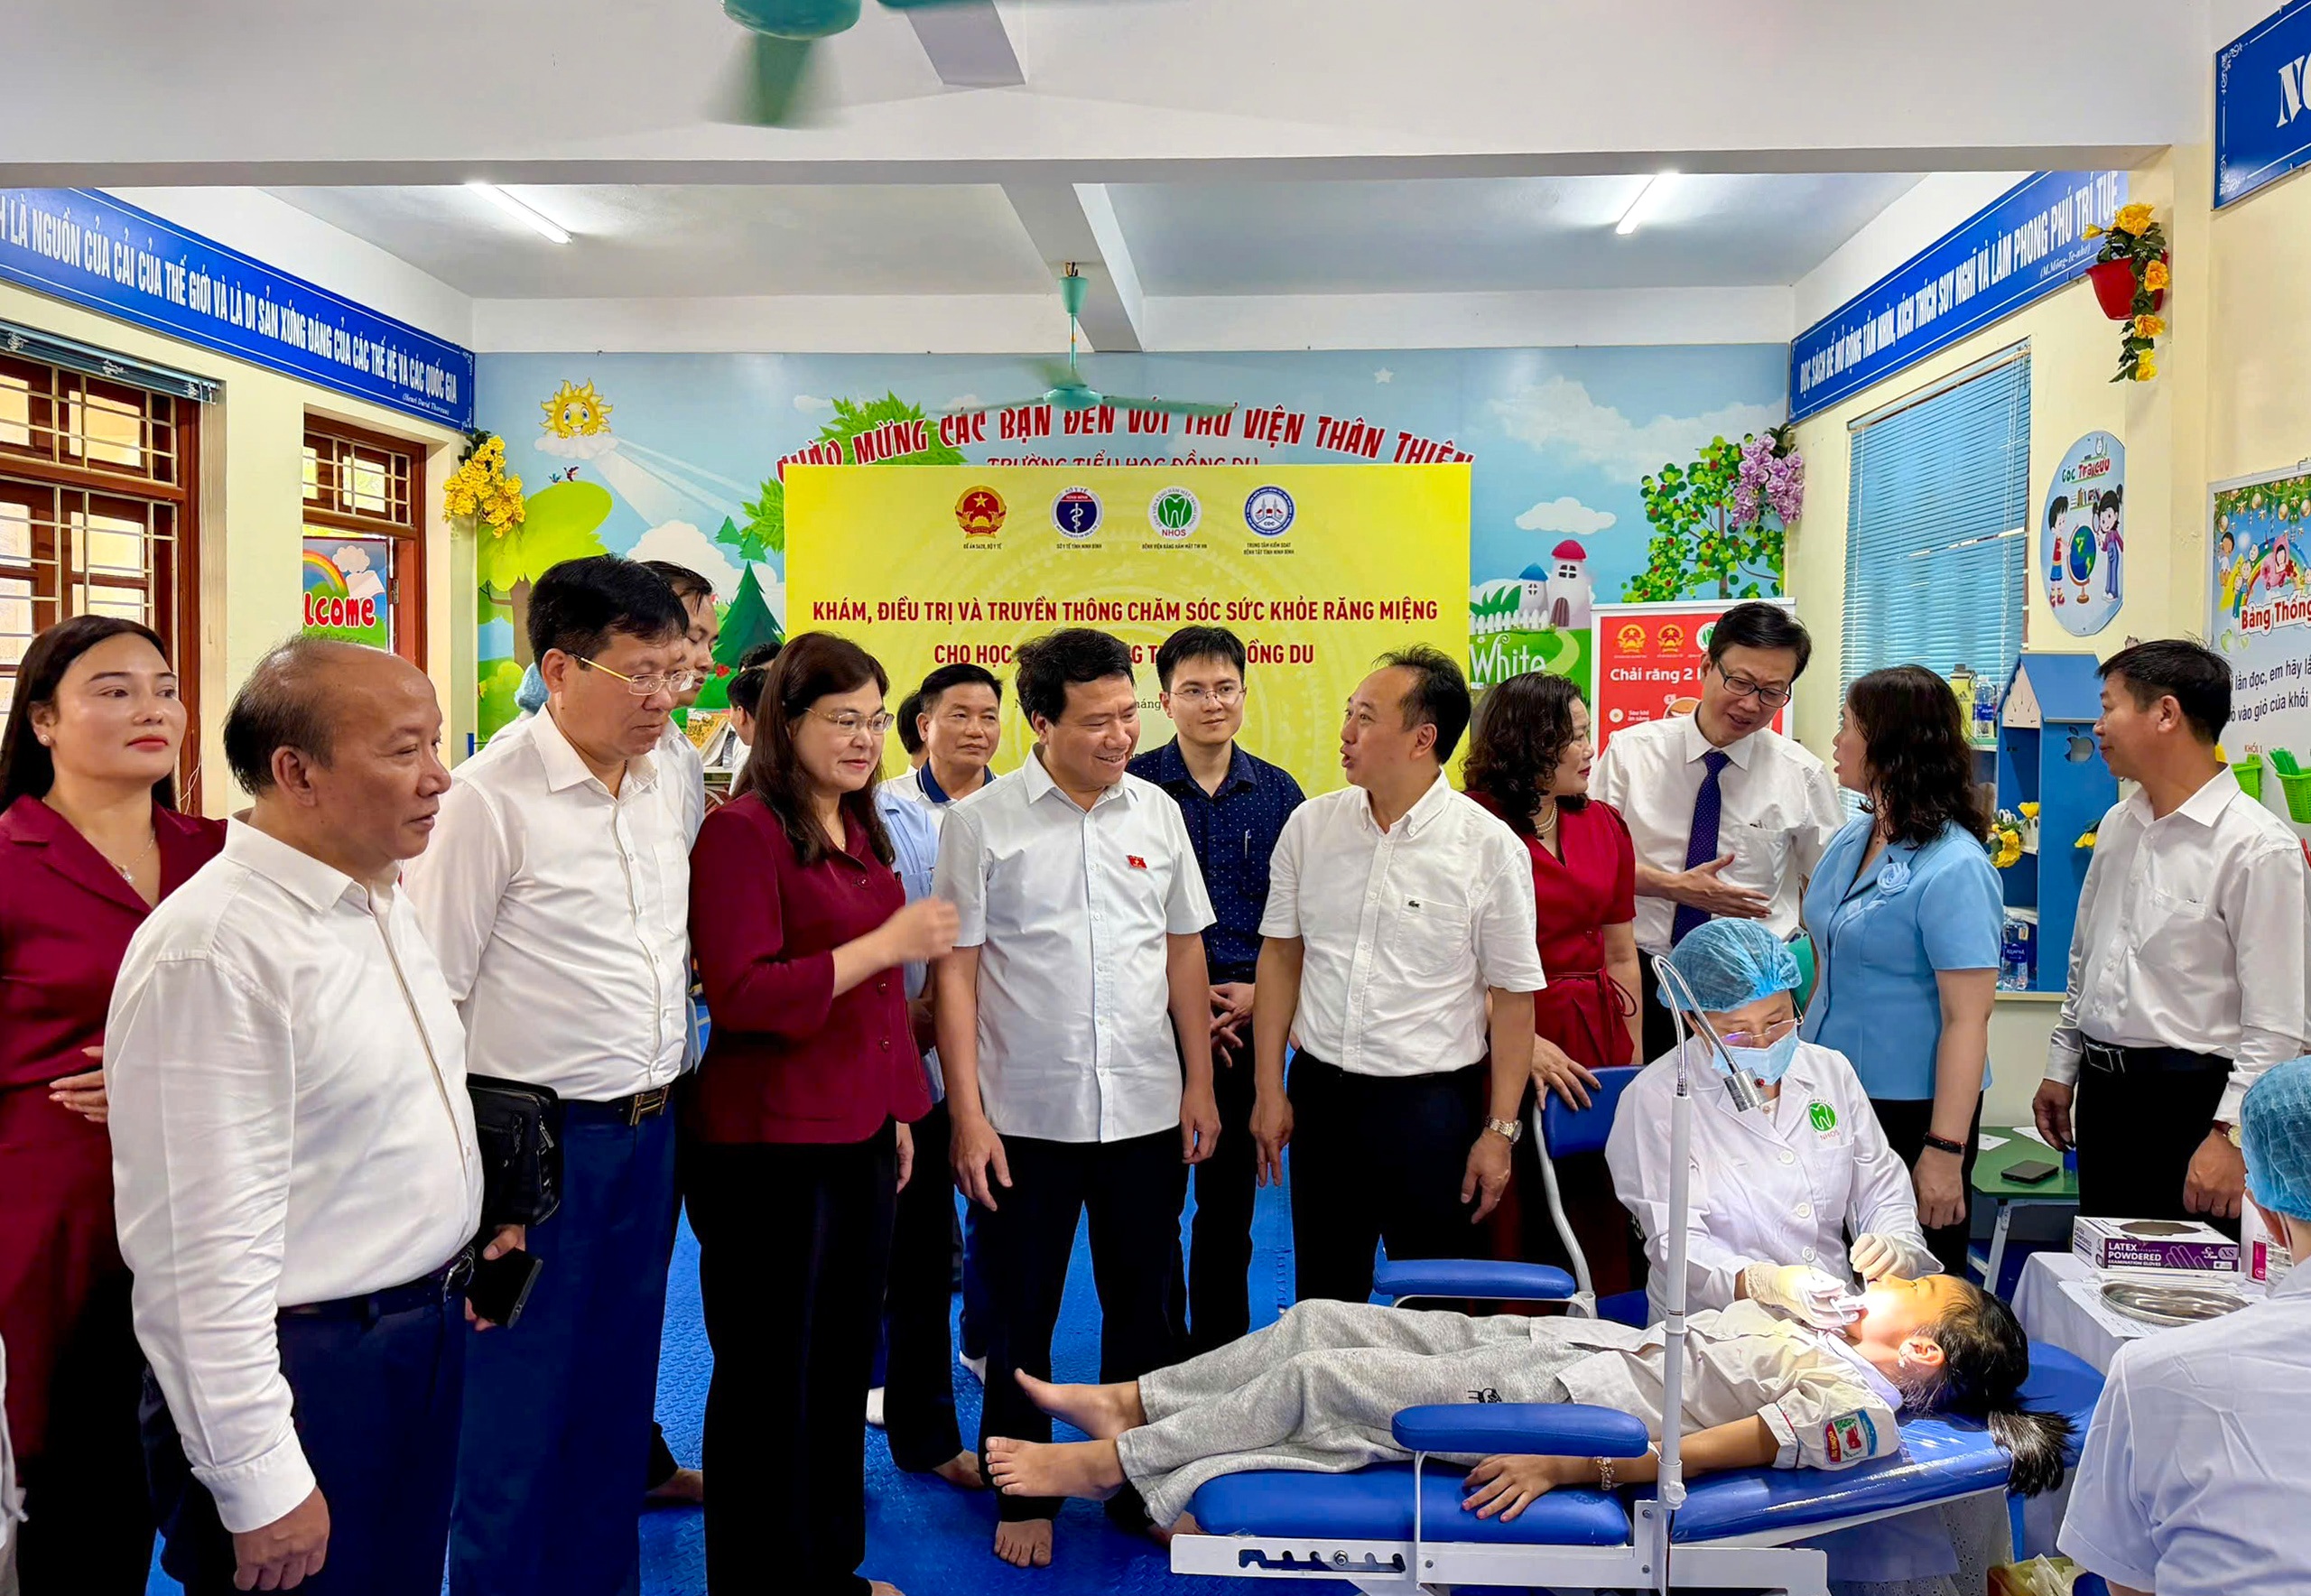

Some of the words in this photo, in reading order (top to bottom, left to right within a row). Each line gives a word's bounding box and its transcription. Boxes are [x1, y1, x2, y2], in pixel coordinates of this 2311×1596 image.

[1897, 292, 1915, 340] KÍCH
[1915, 278, 1937, 329] THÍCH
[1938, 268, 1954, 316] SUY
[1977, 238, 1990, 292] VÀ
[1991, 229, 2012, 285] LÀM
[2013, 210, 2048, 273] PHONG
[2050, 184, 2073, 252] PHÚ
[2075, 171, 2093, 237] TRÍ
[10, 193, 28, 248] LÀ
[32, 207, 80, 268] NGUỒN
[84, 215, 110, 279] CỦA
[114, 227, 135, 288] CẢI
[137, 237, 162, 298] CỦA
[164, 255, 187, 306] THẾ
[189, 264, 211, 315] GIỚI
[213, 274, 227, 321] VÀ
[229, 281, 243, 327] LÀ
[245, 292, 255, 331] DI
[258, 284, 279, 339] SẢN
[280, 299, 306, 349] XỨNG
[308, 313, 332, 359] ĐÁNG
[334, 316, 351, 367] CỦA
[353, 330, 369, 373] CÁC
[370, 336, 386, 378] THẾ
[386, 344, 397, 389] HỆ
[398, 348, 408, 386] VÀ
[409, 353, 424, 392] CÁC
[425, 357, 444, 399] QUỐC
[445, 372, 457, 404] GIA
[853, 419, 928, 465] MỪNG
[940, 406, 987, 446] CÁC
[1000, 404, 1052, 444] BẠN
[1243, 404, 1305, 449] VIỆN
[1315, 416, 1386, 459] THÂN
[1162, 528, 1186, 537] NHOS
[305, 593, 376, 626] lcome
[812, 597, 873, 626] KHÁM,
[877, 596, 919, 621] ĐIỀU
[923, 601, 953, 626] TRỊ
[958, 597, 983, 621] VÀ
[987, 596, 1057, 621] TRUYỀN
[1062, 597, 1123, 621] THÔNG
[1128, 598, 1180, 621] CHĂM
[1185, 597, 1220, 621] SÓC
[1226, 596, 1265, 621] SỨC
[1270, 595, 1318, 621] KHỎE
[1323, 597, 1374, 621] RĂNG
[1379, 596, 1438, 624] MIỆNG
[2241, 606, 2270, 630] Bảng
[2274, 594, 2311, 622] Thống
[934, 645, 971, 664] CHO
[976, 645, 1013, 668] HỌC
[1247, 638, 1284, 663] ỒNG
[1289, 645, 1314, 664] DU
[1469, 633, 1546, 683] White
[1610, 666, 1642, 682] Chải
[1645, 668, 1680, 684] răng
[1683, 668, 1694, 681] 2
[2234, 671, 2247, 691] lần
[2249, 671, 2267, 691] đọc,
[2269, 665, 2283, 681] em
[2285, 659, 2302, 679] hãy
[1136, 698, 1161, 711] áng
[2238, 704, 2252, 721] vào
[2254, 698, 2268, 721] giỏ
[2269, 693, 2286, 712] của
[2288, 686, 2308, 708] khối
[1820, 1129, 1840, 1141] NHOS
[2108, 1242, 2137, 1252] LATEX
[2108, 1251, 2162, 1261] POWDERED
[2221, 1248, 2234, 1257] XS
